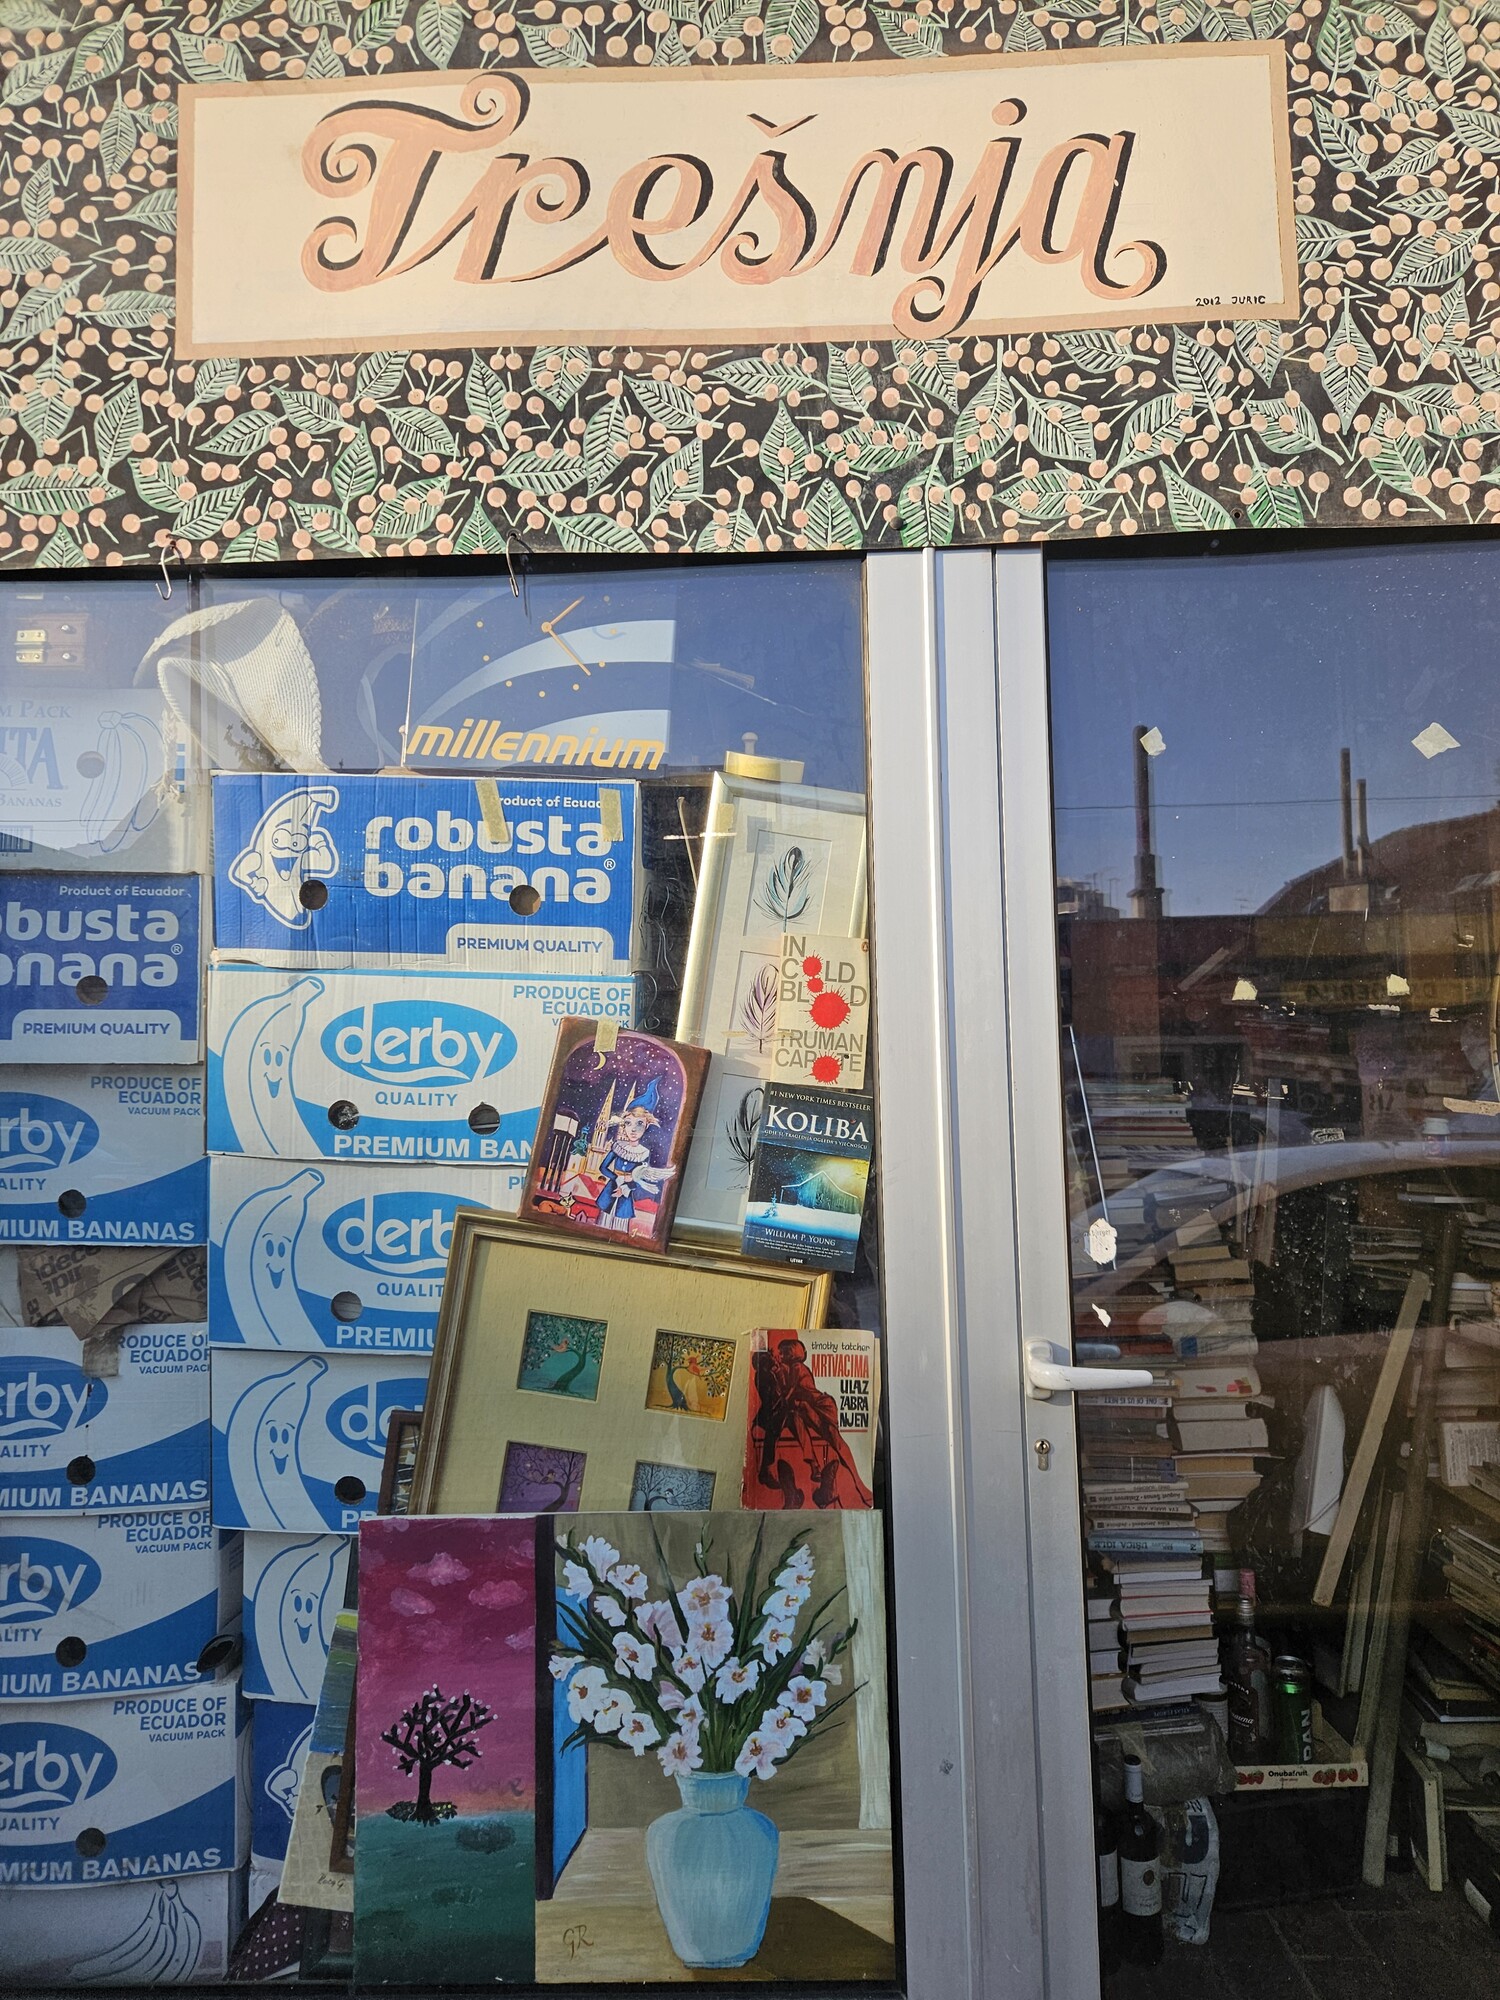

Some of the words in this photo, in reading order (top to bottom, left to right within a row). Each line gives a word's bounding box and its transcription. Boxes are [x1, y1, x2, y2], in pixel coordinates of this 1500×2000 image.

[302, 71, 1168, 340] Trešnja
[1195, 296, 1221, 307] 2012
[406, 718, 665, 771] millennium
[499, 795, 542, 807] roduct
[546, 796, 561, 807] of
[364, 810, 611, 857] robusta
[364, 853, 611, 904] banana
[59, 885, 111, 896] Product
[114, 885, 128, 895] of
[132, 886, 185, 896] Ecuador
[0, 901, 179, 942] busta
[457, 938, 528, 951] PREMIUM
[533, 940, 603, 953] QUALITY
[782, 935, 807, 957] IN
[781, 957, 856, 984] CLD
[513, 985, 601, 1000] PRODUCE
[606, 988, 631, 1001] OF
[780, 981, 867, 1007] BLD
[542, 1001, 631, 1017] ECUADOR
[23, 1023, 96, 1034] PREMIUM
[100, 1023, 170, 1035] QUALITY
[335, 1005, 503, 1081] derby
[777, 1028, 864, 1052] TRUMAN
[774, 1048, 862, 1073] CAPTE
[91, 1076, 173, 1090] PRODUCE
[178, 1077, 202, 1091] OF
[118, 1091, 201, 1105] ECUADOR
[375, 1091, 458, 1107] QUALITY
[796, 1094, 815, 1103] YORK
[816, 1097, 836, 1106] TIMES
[128, 1107, 171, 1116] VACUUM
[173, 1107, 201, 1116] PACK
[766, 1104, 869, 1143] KOLIBA
[334, 1135, 470, 1158] PREMIUM
[68, 1220, 195, 1241] BANANAS
[765, 1228, 798, 1240] WILLIAM
[807, 1235, 836, 1247] YOUNG
[376, 1282, 445, 1297] QUALIT
[117, 1334, 186, 1349] RODUCE
[192, 1334, 208, 1346] O
[811, 1341, 839, 1352] timothy
[841, 1342, 870, 1351] tatcher
[139, 1365, 183, 1374] VACUUM
[186, 1364, 210, 1373] PAC
[811, 1354, 869, 1378] MRTVACIMA
[840, 1379, 869, 1395] ULAZ
[0, 1371, 94, 1433] rby
[840, 1396, 869, 1411] ZABRA
[839, 1413, 869, 1428] NJEN
[70, 1479, 208, 1507] BANANAS
[98, 1512, 183, 1529] PRODUCE
[189, 1510, 212, 1524] OF
[126, 1525, 212, 1543] ECUADOR
[135, 1543, 180, 1554] VACUUM
[183, 1541, 212, 1551] PACK
[0, 1628, 42, 1642] LITY
[62, 1663, 202, 1693] BANANAS
[113, 1698, 197, 1716] PRODUCE
[203, 1696, 227, 1711] OF
[140, 1712, 226, 1731] ECUADOR
[149, 1731, 194, 1743] VACUUM
[196, 1729, 226, 1741] PACK
[83, 1848, 222, 1881] BANANAS
